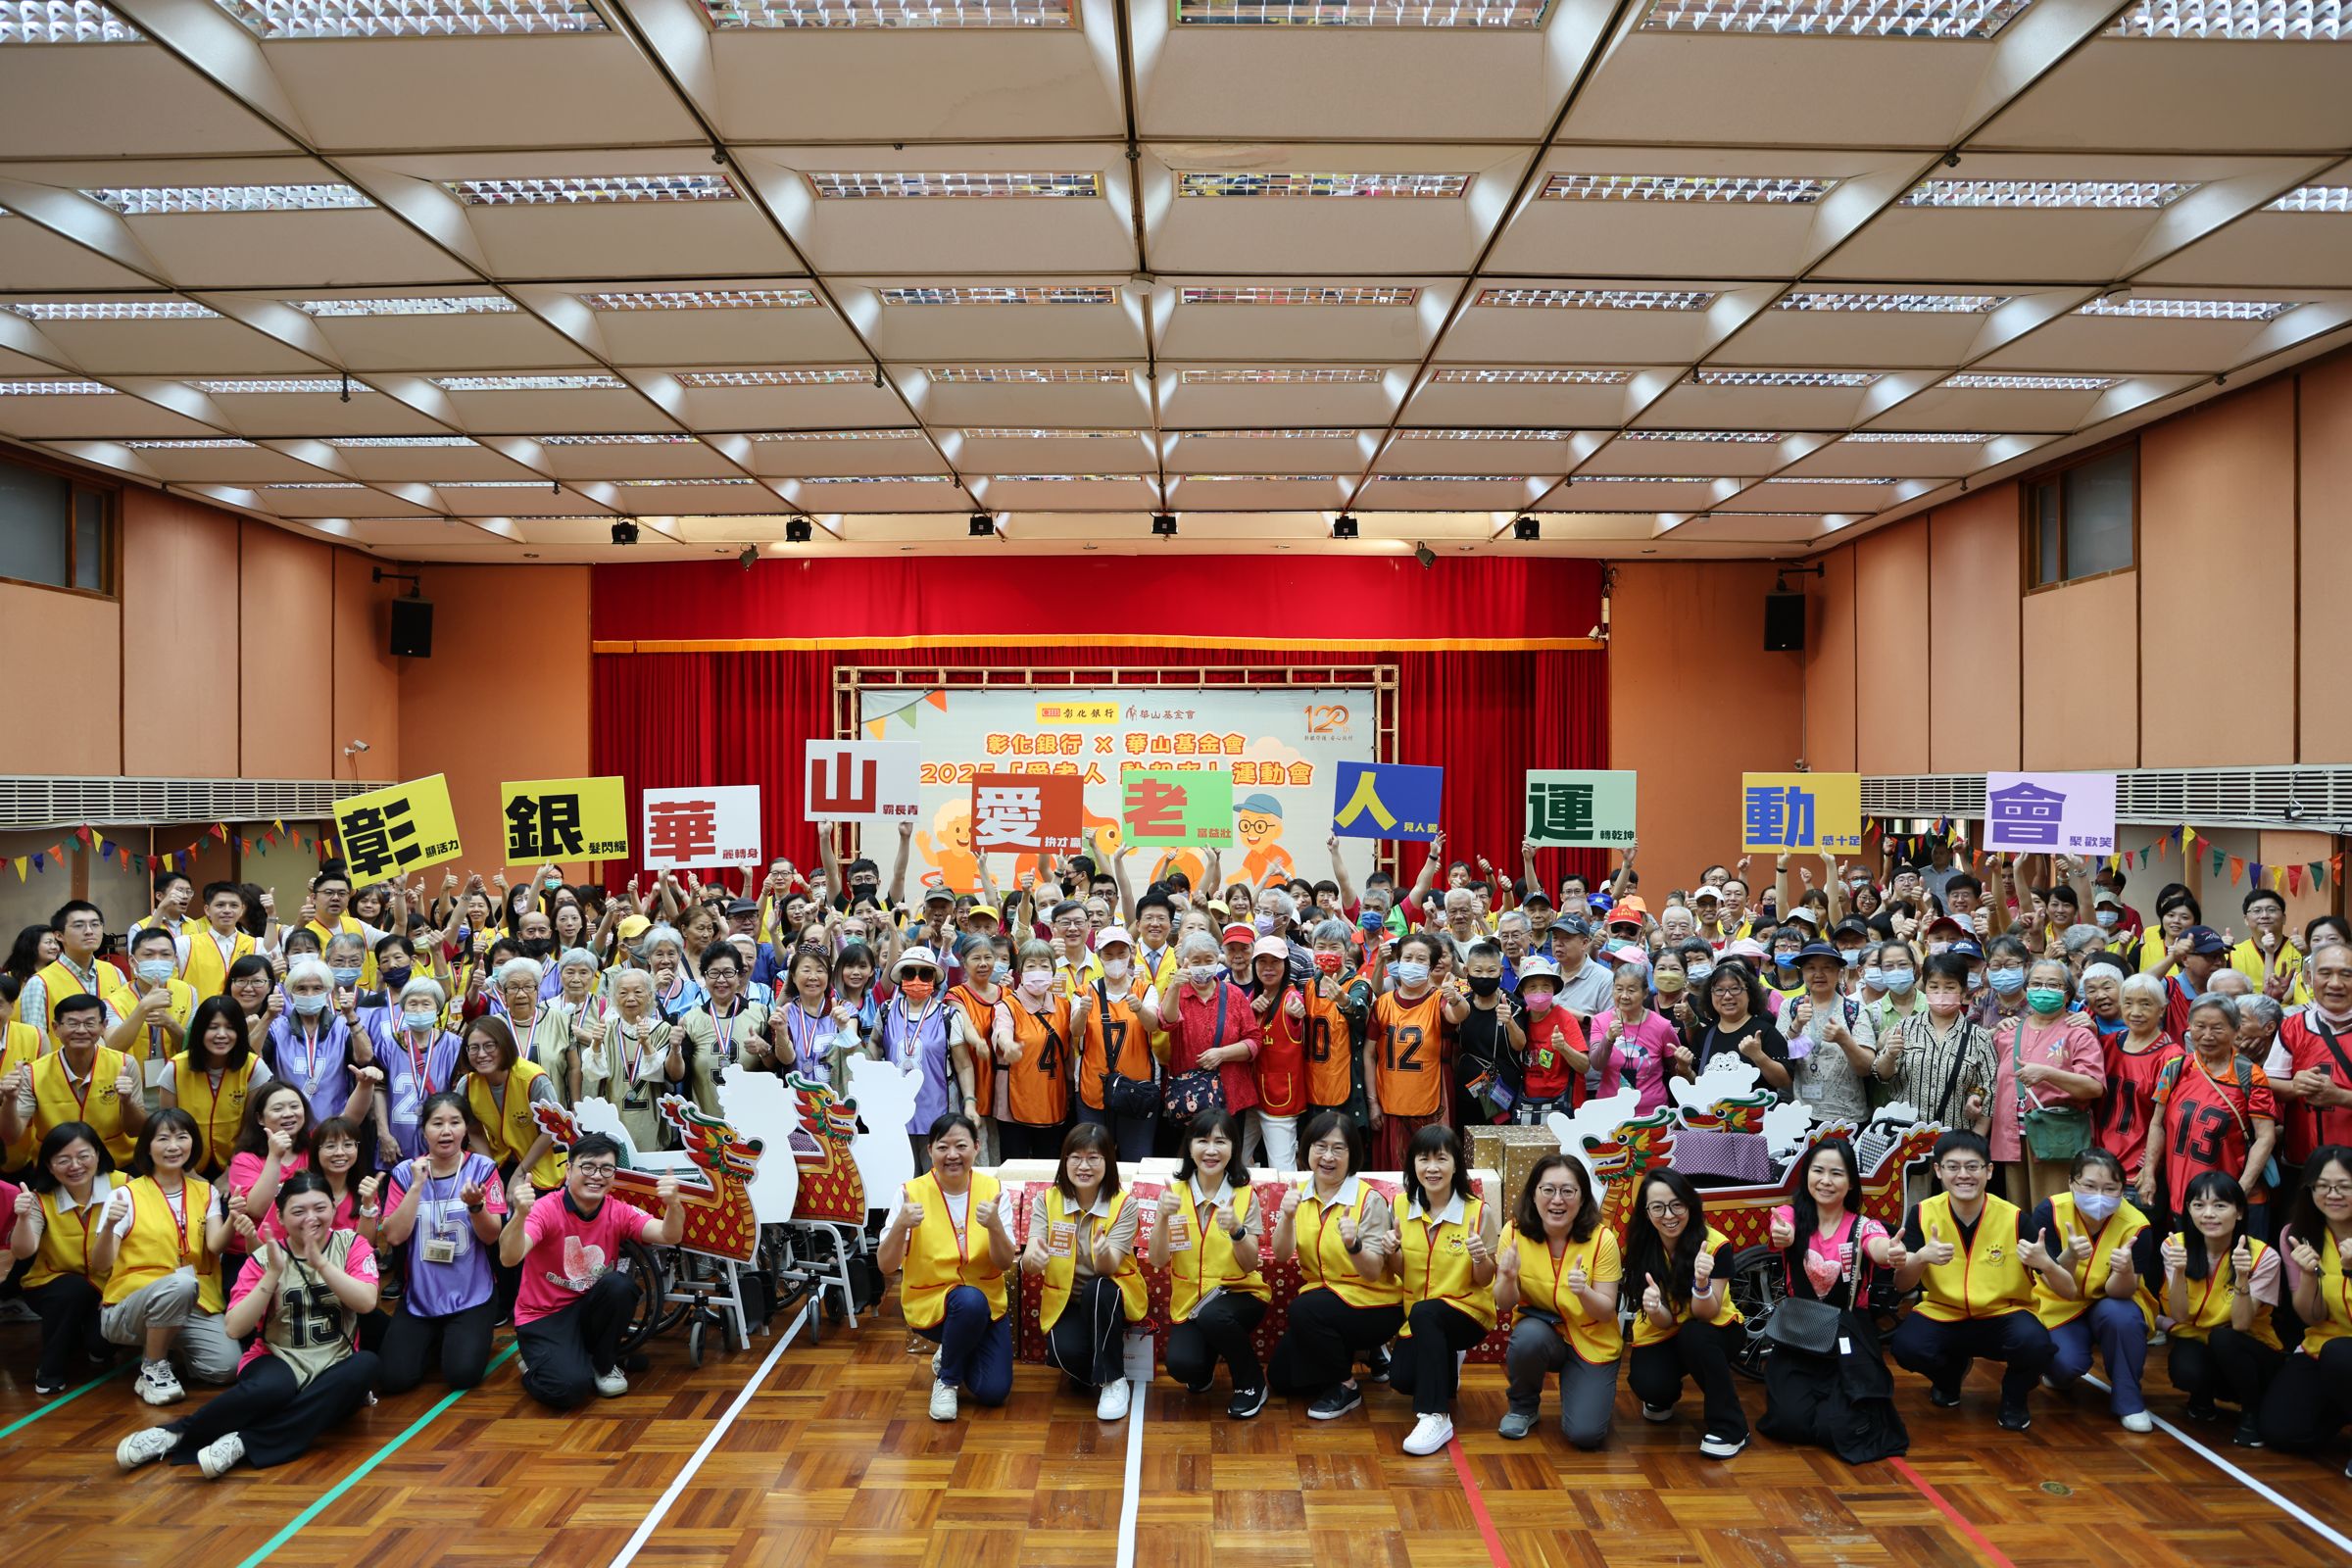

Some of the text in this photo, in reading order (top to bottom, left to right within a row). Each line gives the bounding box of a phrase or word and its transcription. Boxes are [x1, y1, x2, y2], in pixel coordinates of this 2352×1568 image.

[1042, 708, 1060, 716] CHB
[1063, 707, 1114, 718] 彰化銀行
[1140, 709, 1196, 720] 華山基金會
[986, 733, 1083, 755] 彰化銀行
[1125, 733, 1246, 755] 華山基金會
[810, 752, 876, 813] 山
[1232, 761, 1313, 785] 運動會
[975, 786, 1041, 848] 愛
[1123, 778, 1187, 837] 老
[1334, 771, 1397, 831] 人
[1528, 783, 1593, 841] 運
[1745, 785, 1815, 848] 動
[1988, 781, 2067, 846] 會
[340, 797, 421, 877] 彰
[424, 840, 460, 859] 顯活力
[505, 794, 584, 859] 銀
[588, 840, 627, 856] 髮閃耀
[648, 800, 716, 862] 華
[1403, 821, 1438, 833] 見人愛
[1600, 830, 1635, 841] 轉乾坤
[1822, 835, 1860, 846] 感十足
[2069, 836, 2113, 848] 聚歡笑
[722, 848, 759, 860] 麗轉身
[710, 1037, 740, 1086] 3
[1037, 1032, 1056, 1080] 4
[1383, 1023, 1424, 1072] 12
[293, 1057, 326, 1102] 7
[393, 1072, 423, 1124] 2
[2173, 1098, 2231, 1166] 13
[416, 1199, 471, 1261] 15
[283, 1283, 343, 1348] 15
